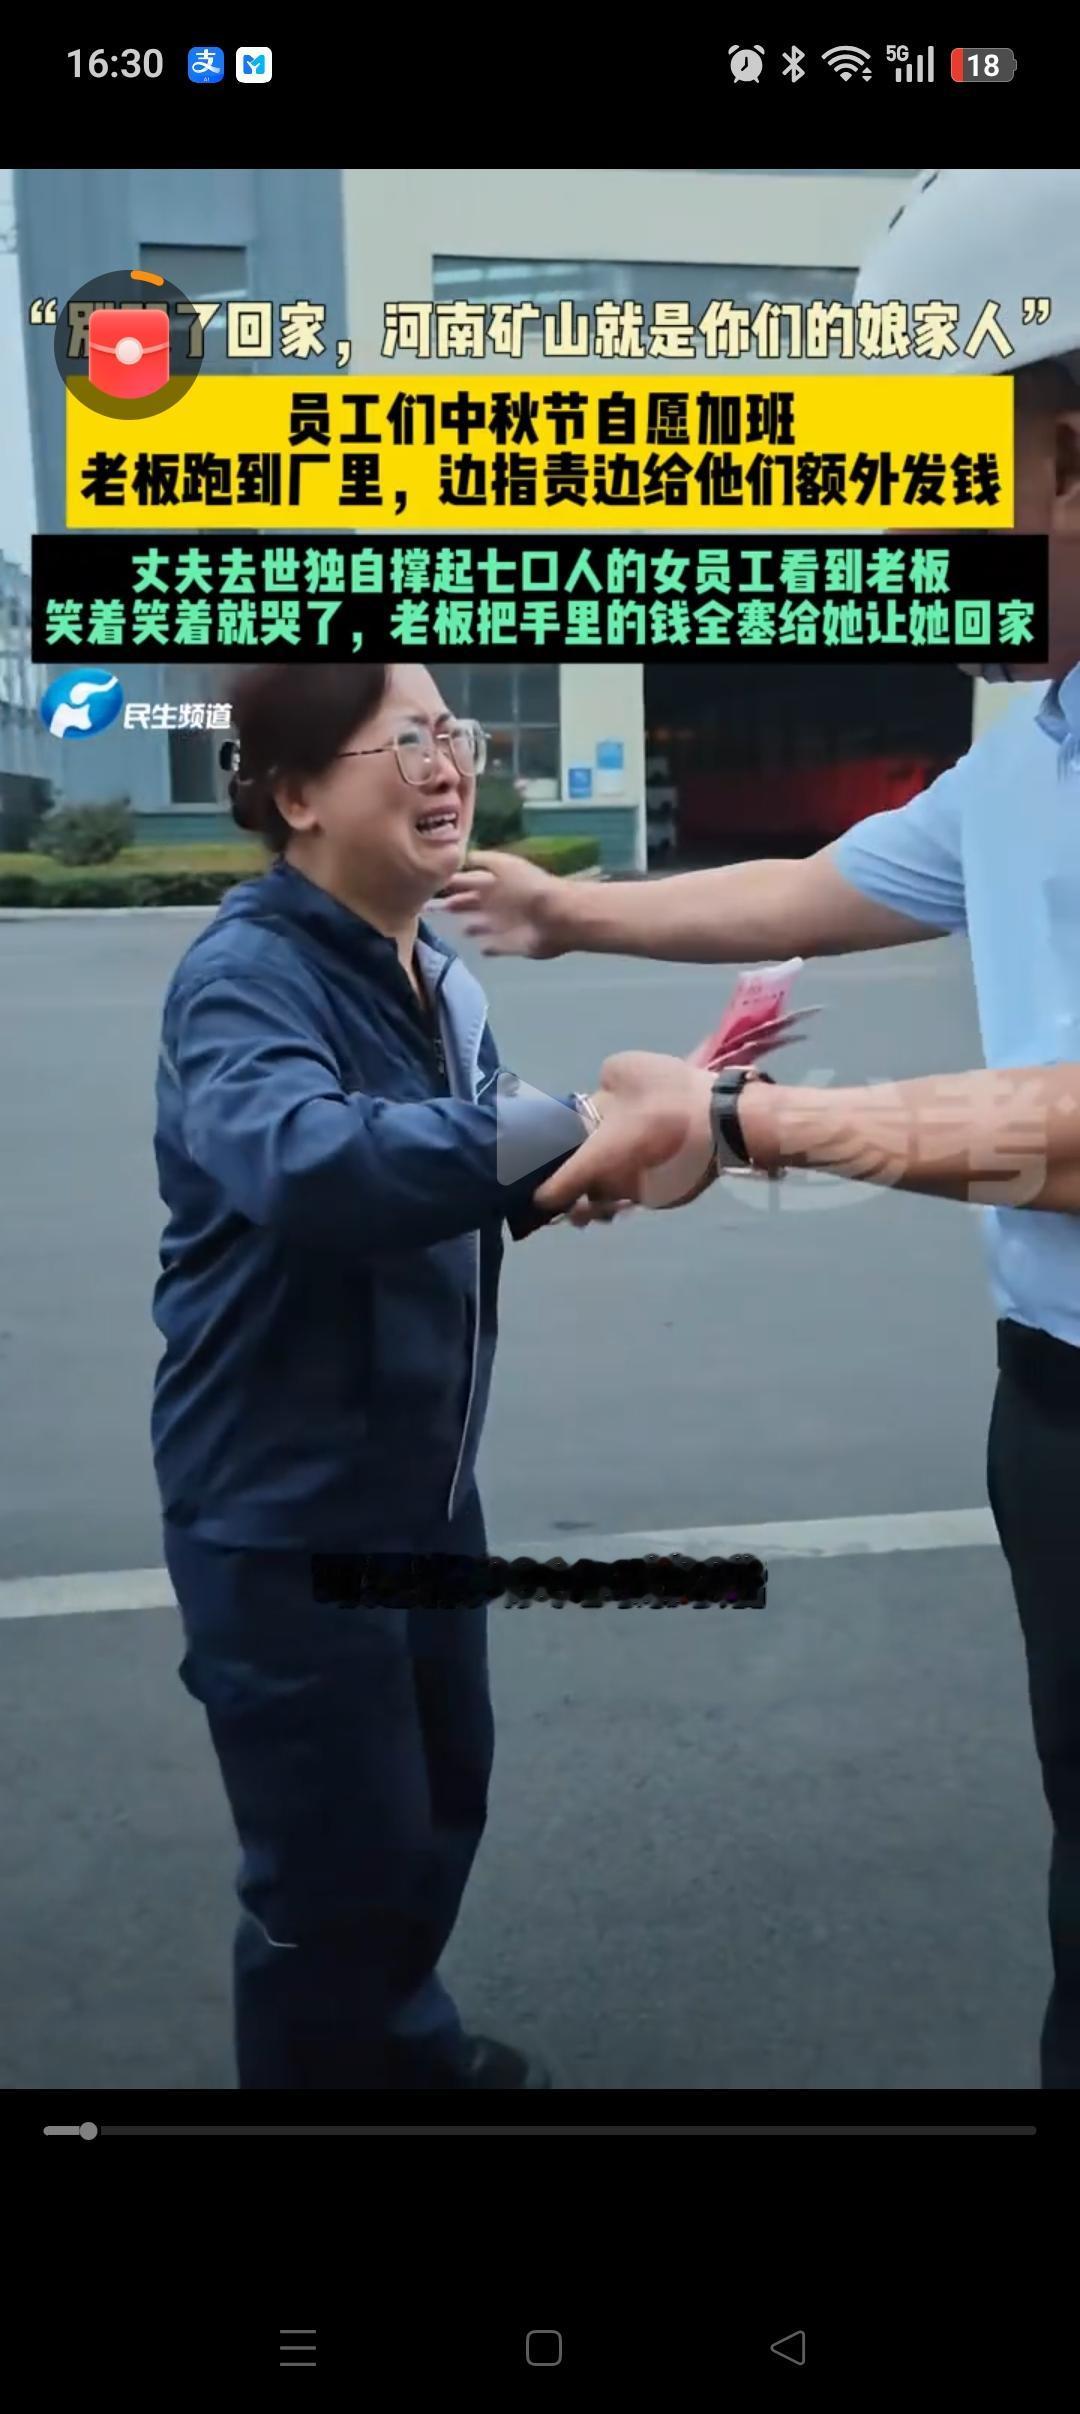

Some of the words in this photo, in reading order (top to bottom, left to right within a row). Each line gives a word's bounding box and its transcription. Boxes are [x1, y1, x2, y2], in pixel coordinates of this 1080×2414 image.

[66, 47, 163, 80] 16:30
[885, 44, 910, 62] 5G
[966, 53, 1000, 77] 18
